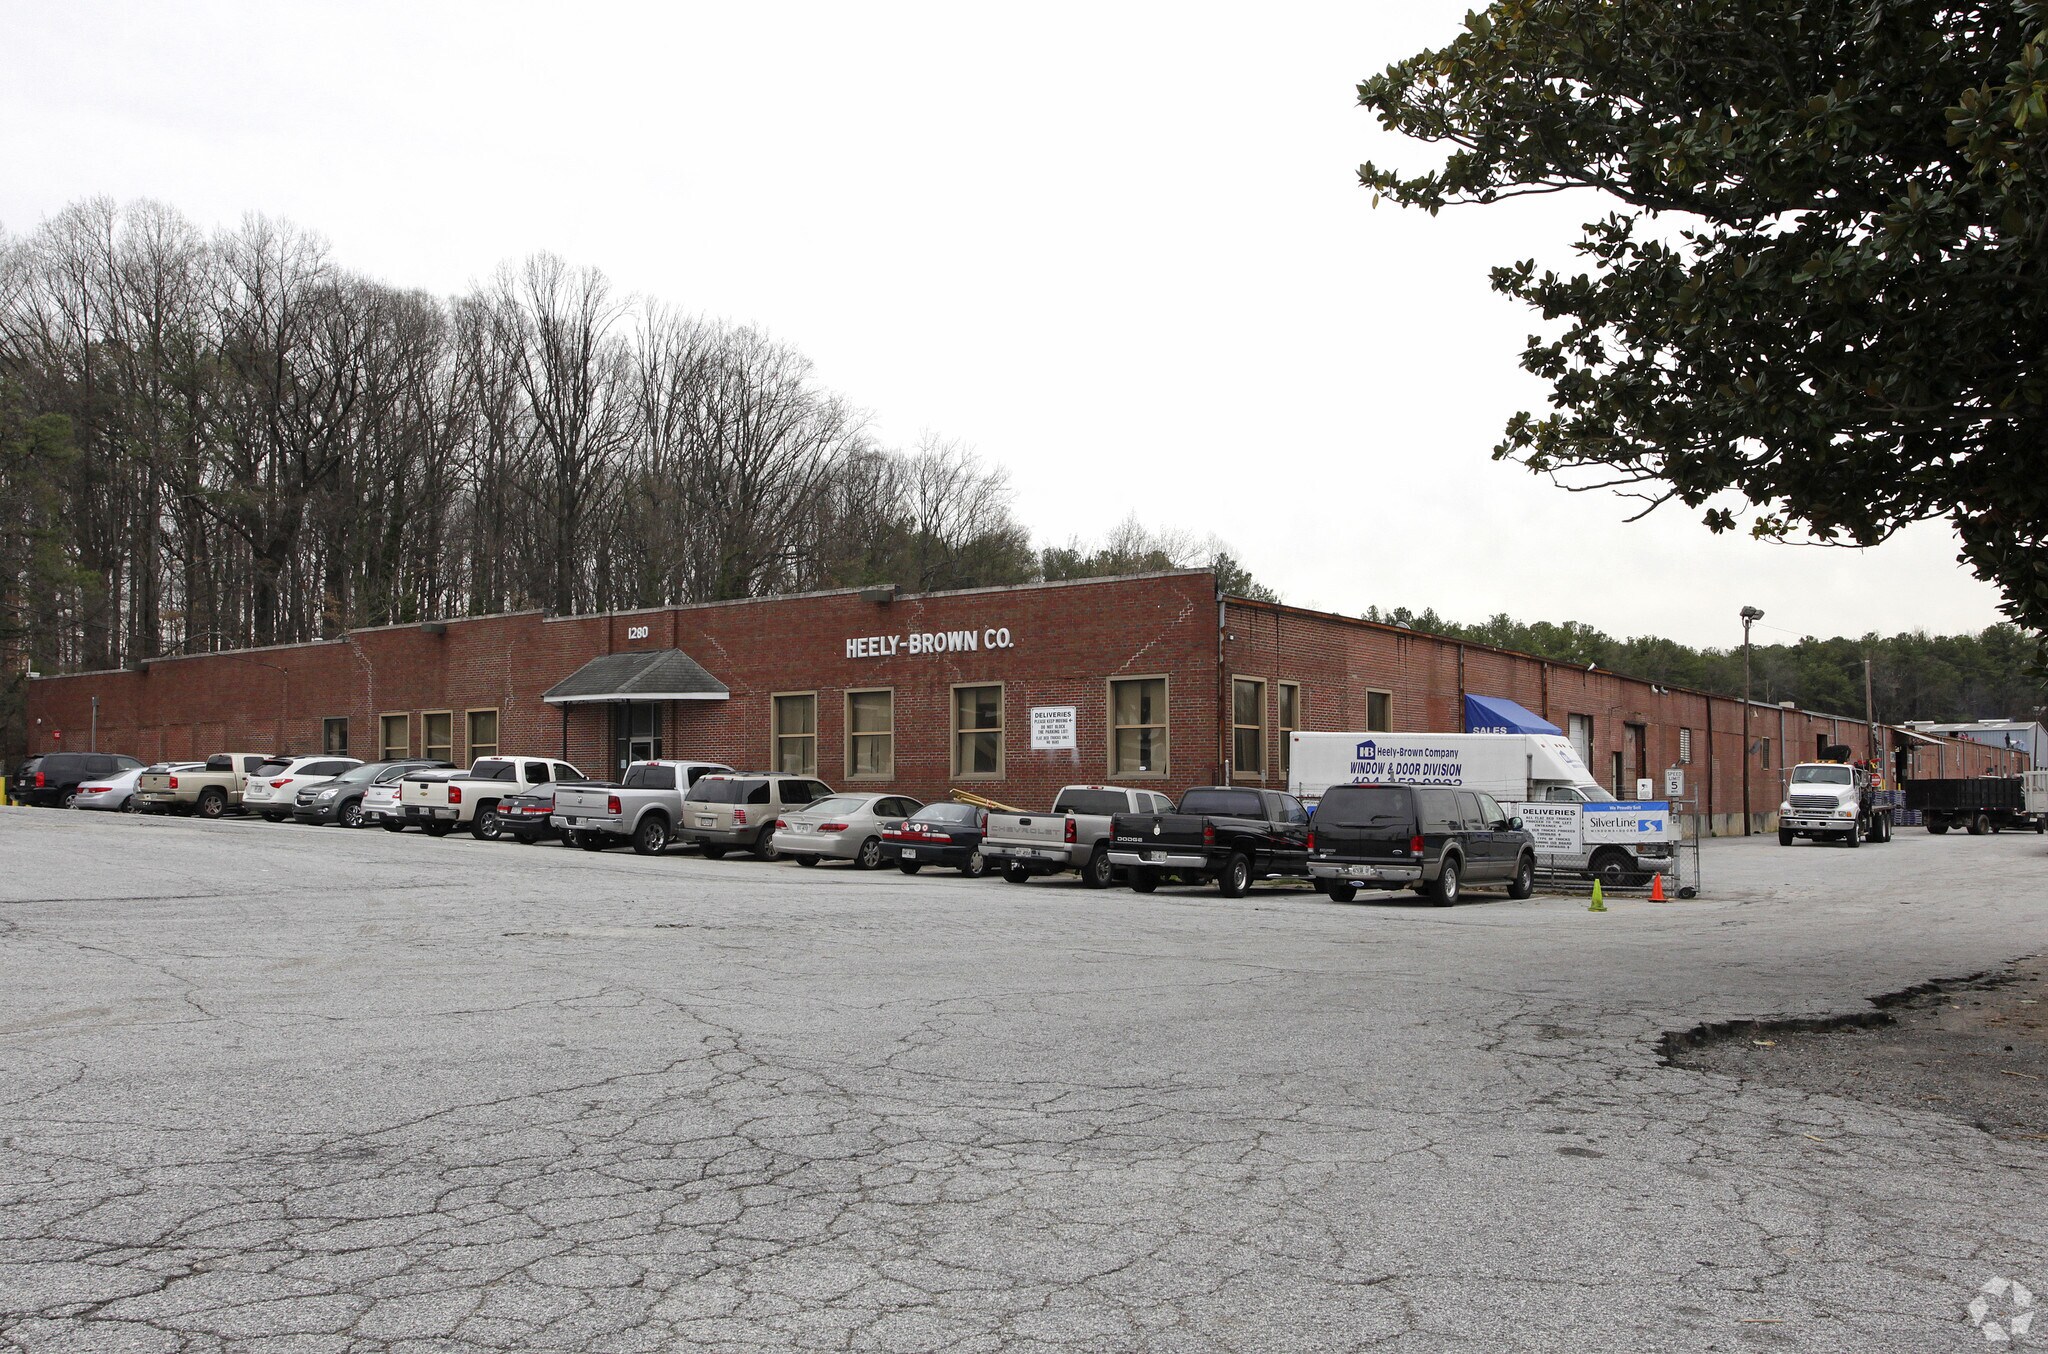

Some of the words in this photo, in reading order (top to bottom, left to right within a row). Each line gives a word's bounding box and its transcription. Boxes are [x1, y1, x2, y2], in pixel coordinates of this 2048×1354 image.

[628, 626, 648, 640] 1280
[846, 630, 978, 658] HEELY-BROWN
[984, 628, 1014, 649] CO.
[1377, 748, 1423, 758] Heely-Brown
[1424, 748, 1458, 759] Company
[1350, 762, 1385, 774] WINDOW
[1396, 763, 1420, 775] DOOR
[1423, 764, 1462, 776] DIVISION
[991, 826, 1061, 835] CHEVROLET
